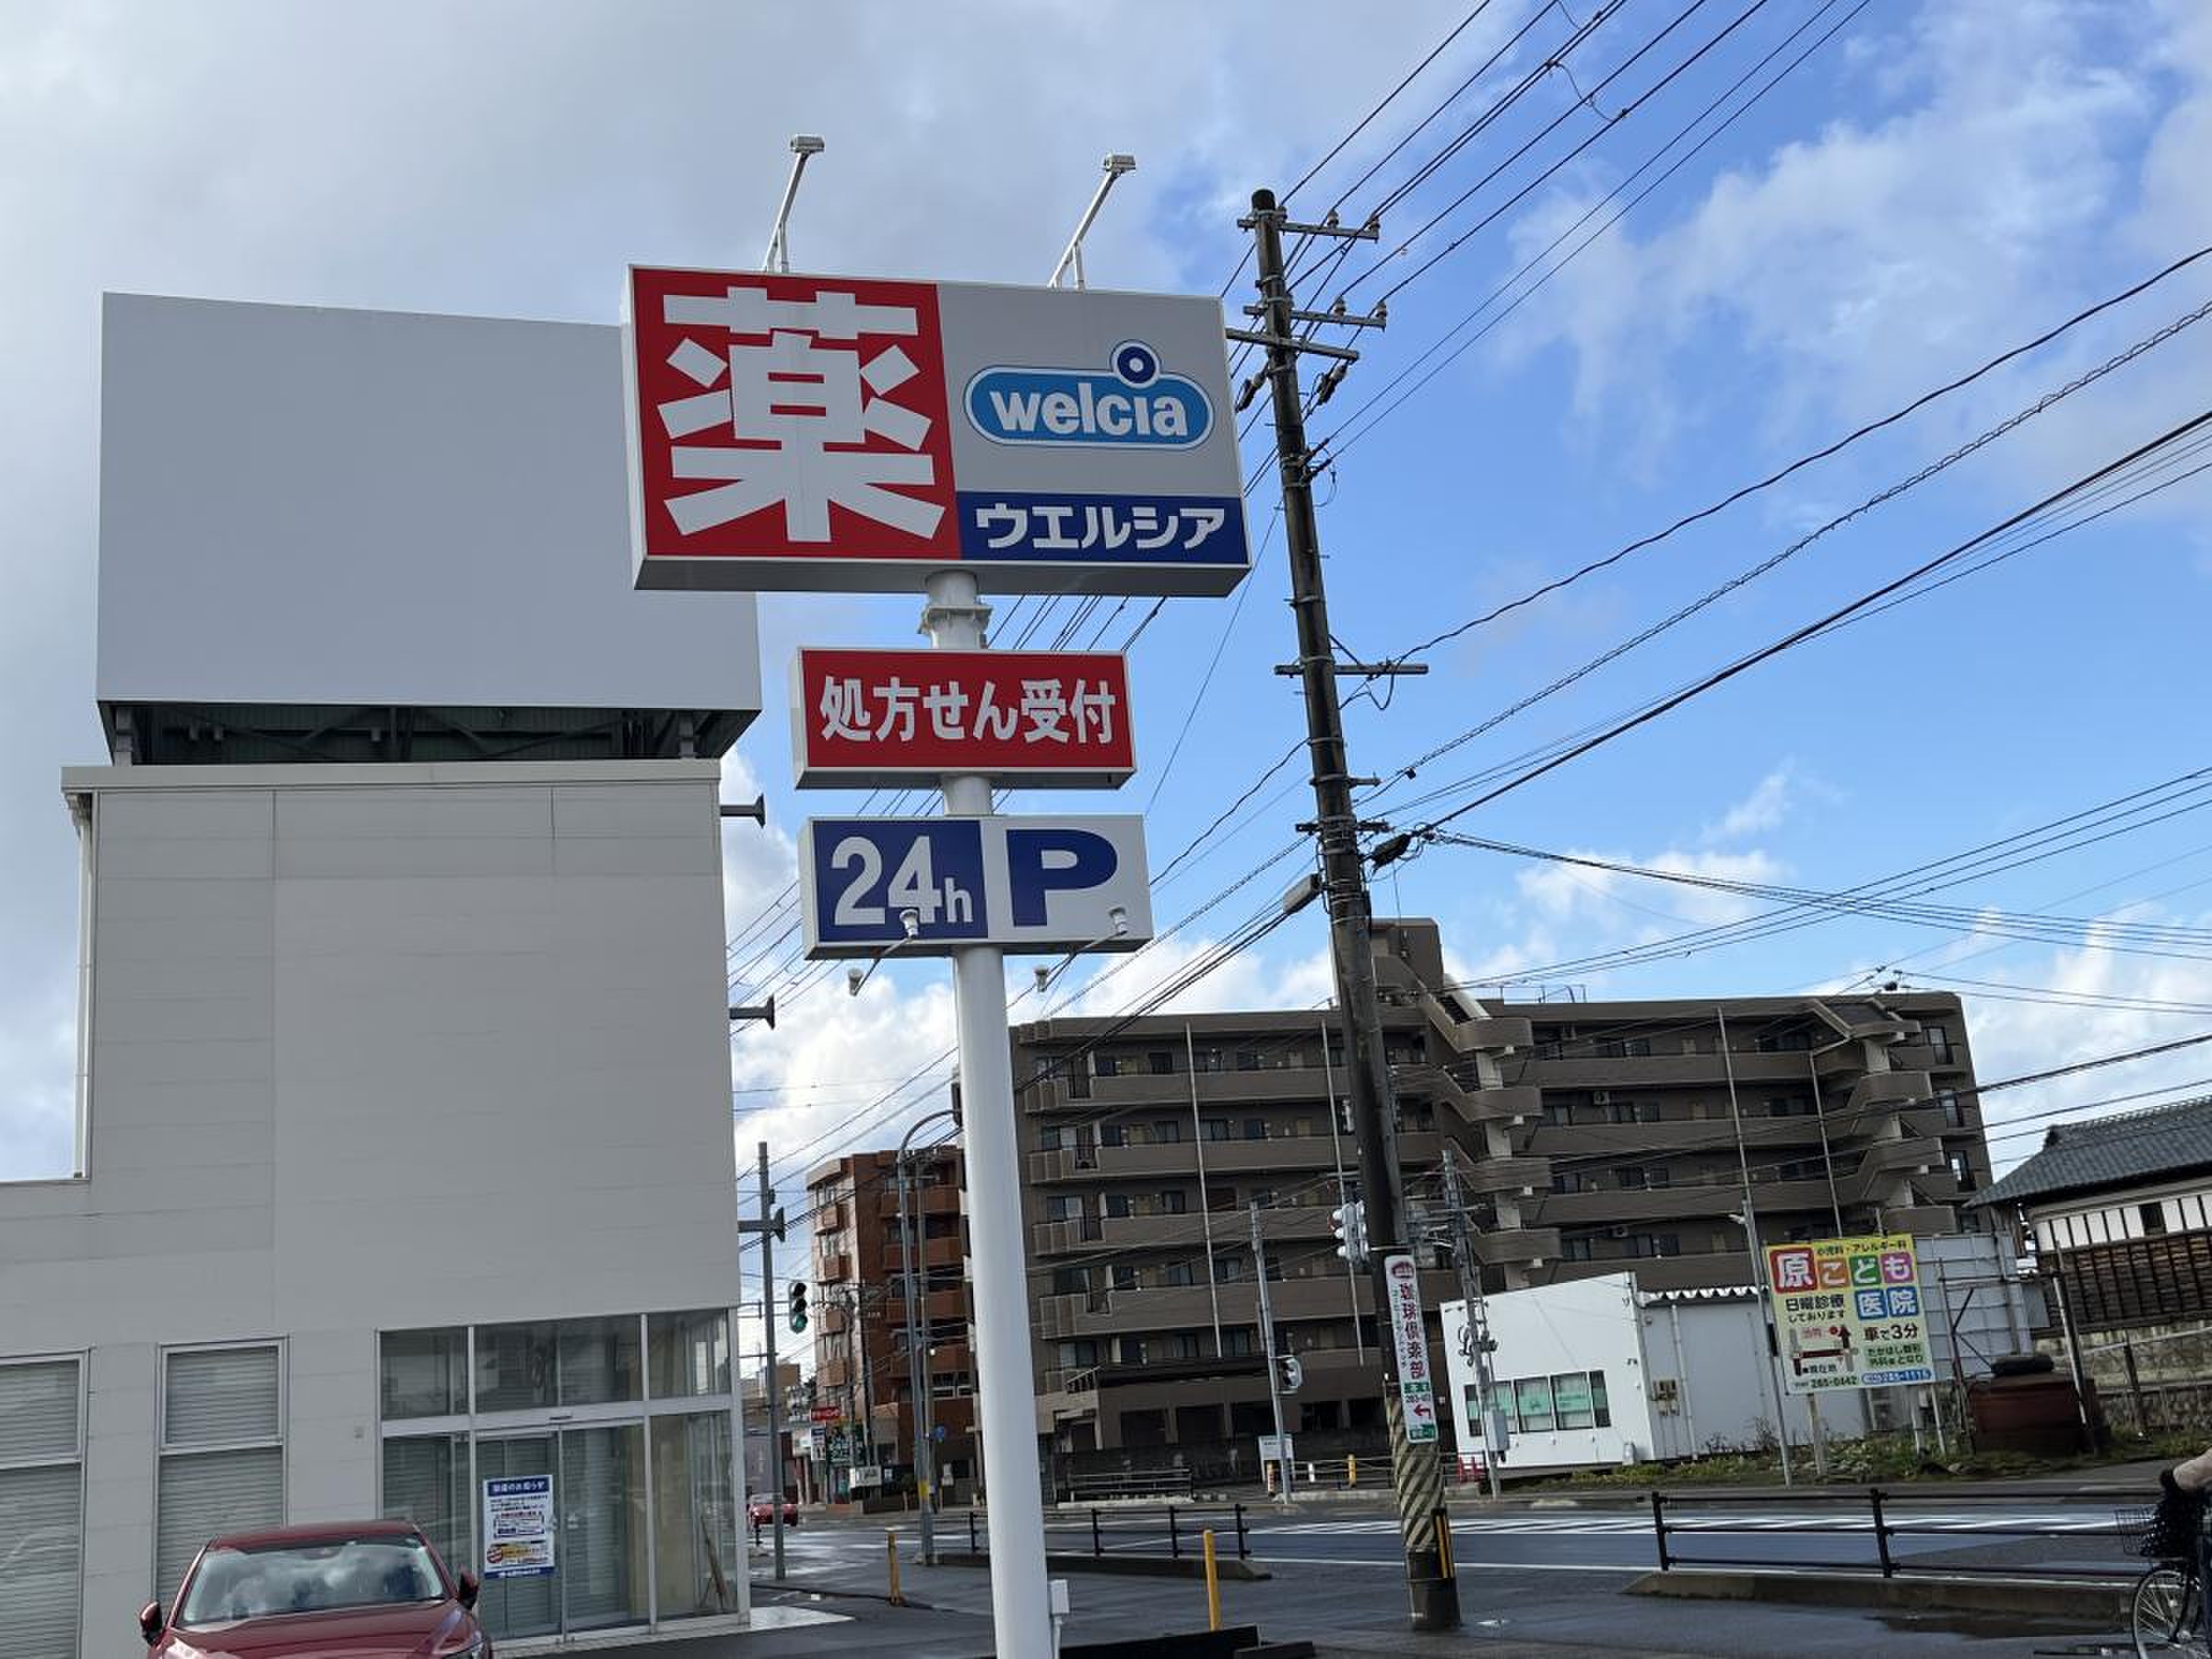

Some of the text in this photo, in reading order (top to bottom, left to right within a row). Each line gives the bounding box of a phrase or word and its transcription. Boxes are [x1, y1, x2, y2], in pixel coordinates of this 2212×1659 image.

[657, 286, 945, 543] 薬
[988, 344, 1188, 438] welcia
[975, 502, 1225, 550] ウエルシア
[819, 676, 1117, 744] 処方せん受付
[831, 835, 974, 926] 24h
[1006, 829, 1119, 927] P
[1777, 1253, 1912, 1288] 原こども
[1857, 1291, 1916, 1317] 医院
[1864, 1324, 1918, 1342] 車で3分
